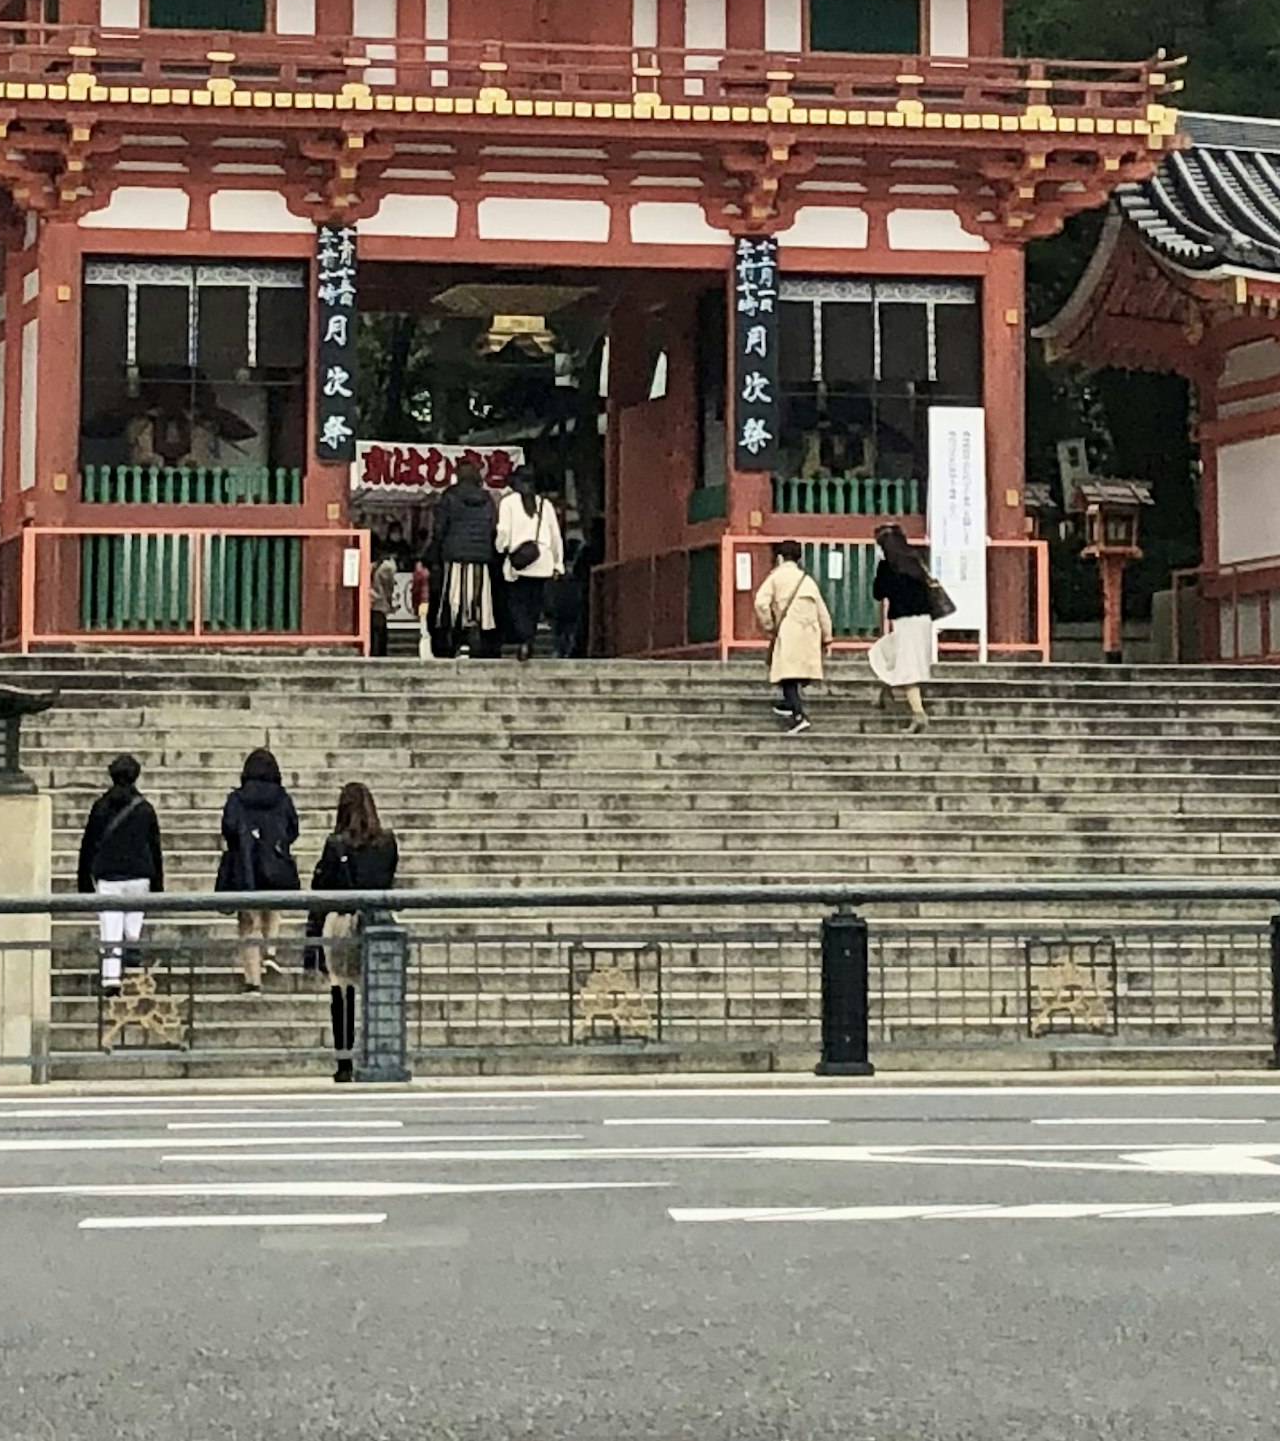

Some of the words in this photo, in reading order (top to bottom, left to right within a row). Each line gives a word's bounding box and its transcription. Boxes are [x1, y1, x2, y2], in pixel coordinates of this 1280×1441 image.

[320, 314, 354, 451] 月次祭
[738, 324, 774, 456] 月次祭
